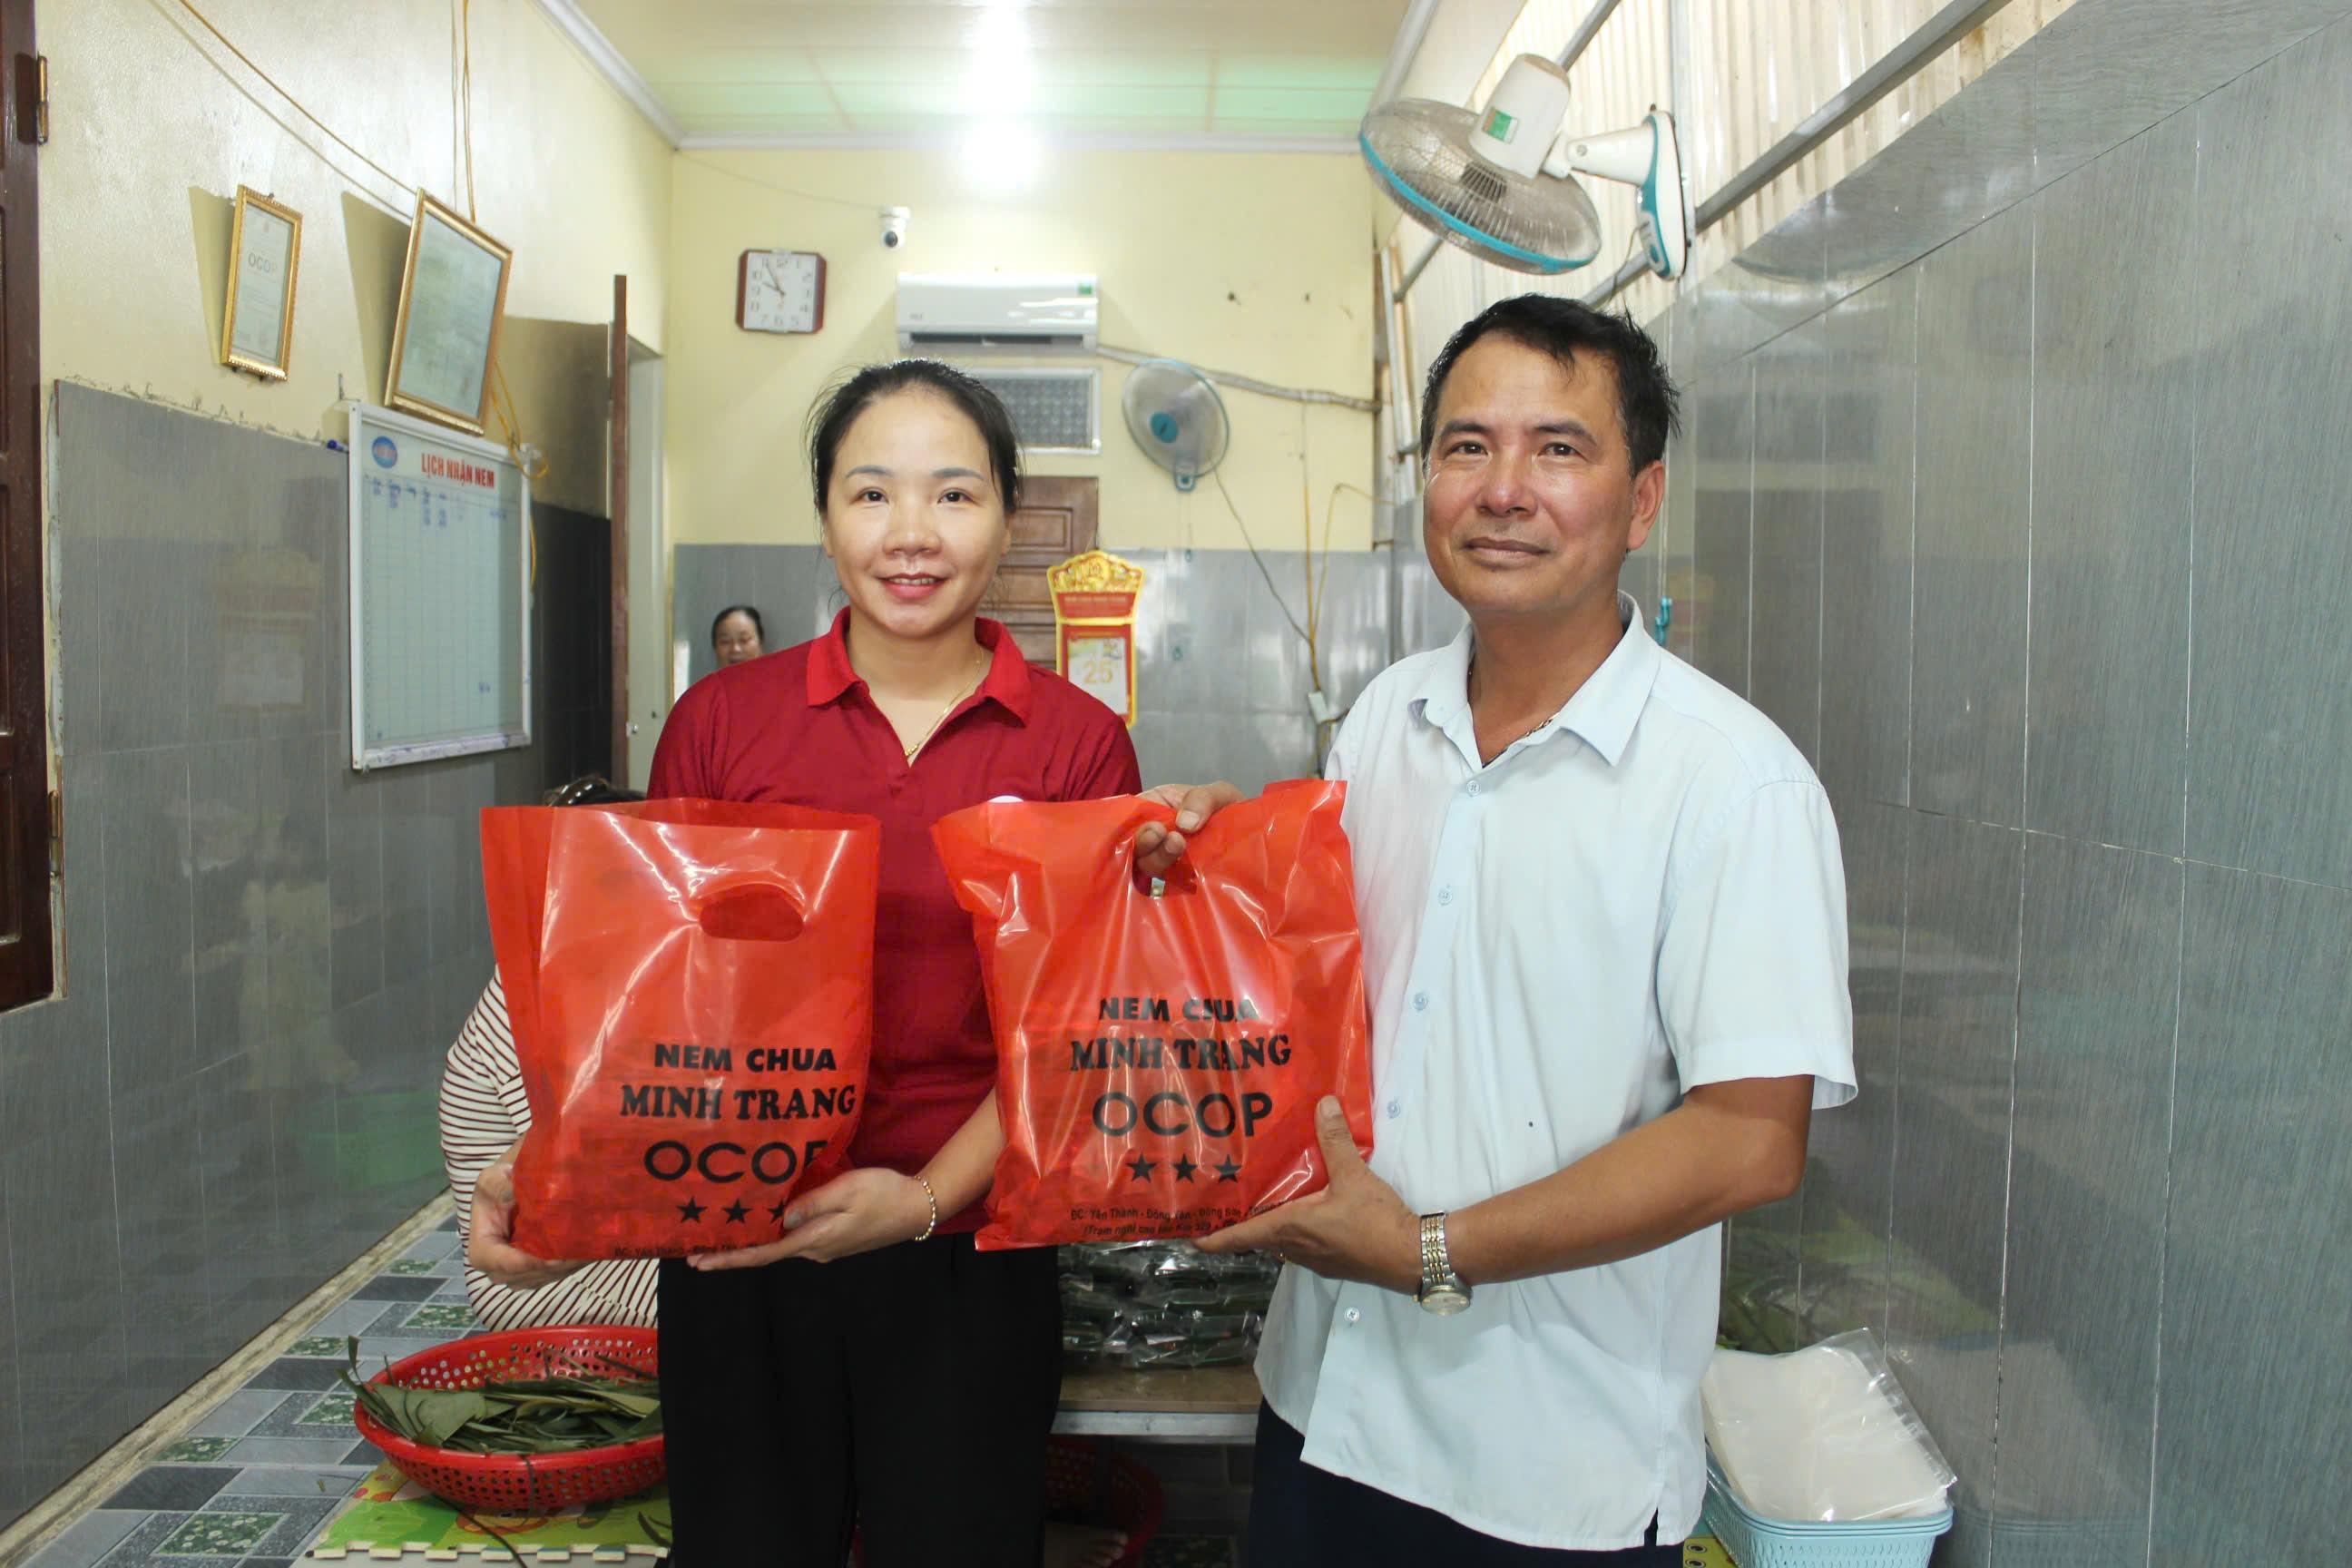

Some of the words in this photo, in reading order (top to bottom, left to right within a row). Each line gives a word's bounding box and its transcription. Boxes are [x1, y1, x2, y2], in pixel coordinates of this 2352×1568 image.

[421, 454, 444, 478] LỊCH
[446, 457, 473, 486] NHẬN
[475, 465, 495, 488] NEM
[1099, 996, 1170, 1022] NEM
[654, 1044, 732, 1072] NEM
[746, 1047, 837, 1073] CHUA
[1070, 1037, 1164, 1071] MINH
[620, 1084, 722, 1120] MINH
[733, 1084, 856, 1121] TRANG
[1093, 1092, 1273, 1138] OCOP
